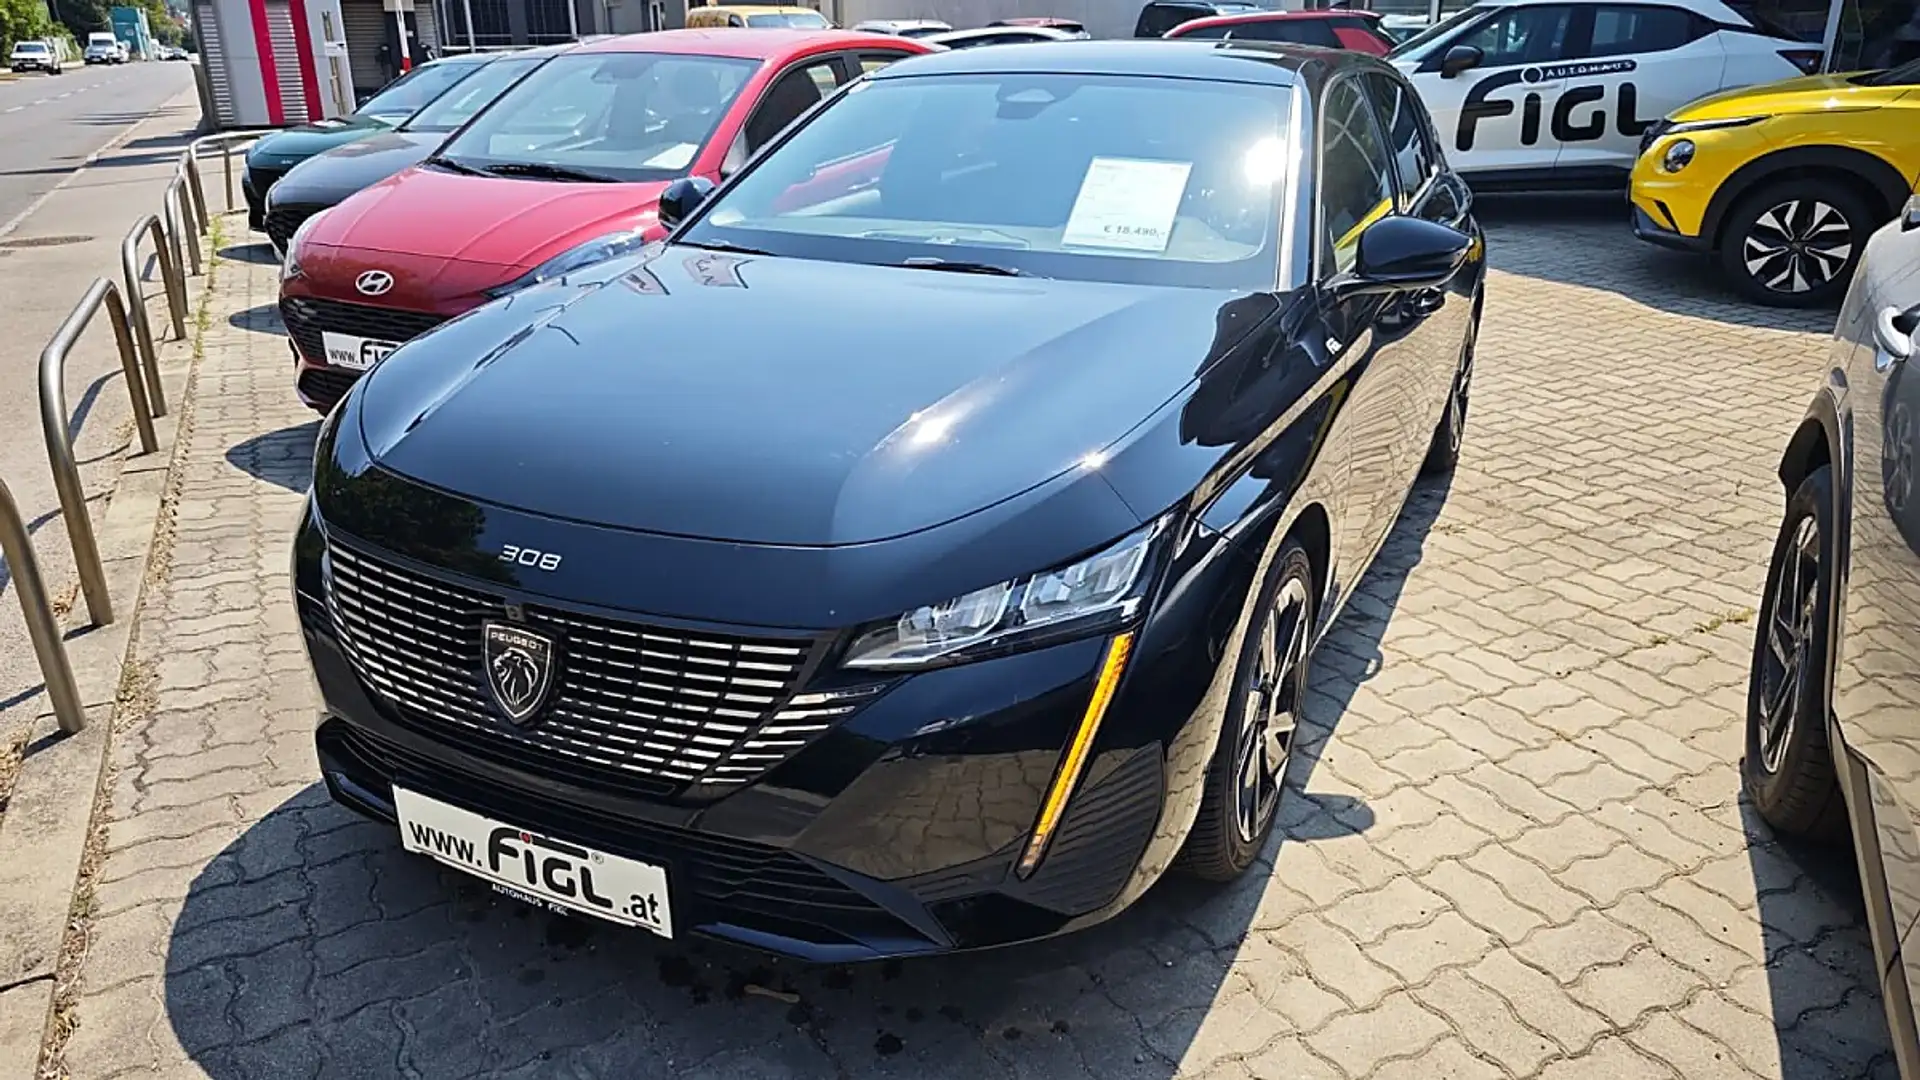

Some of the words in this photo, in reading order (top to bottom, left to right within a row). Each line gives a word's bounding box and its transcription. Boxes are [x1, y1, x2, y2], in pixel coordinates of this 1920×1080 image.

[1546, 61, 1633, 77] AUTOHAUS
[498, 544, 562, 571] 308
[490, 631, 544, 650] PEUGEOT
